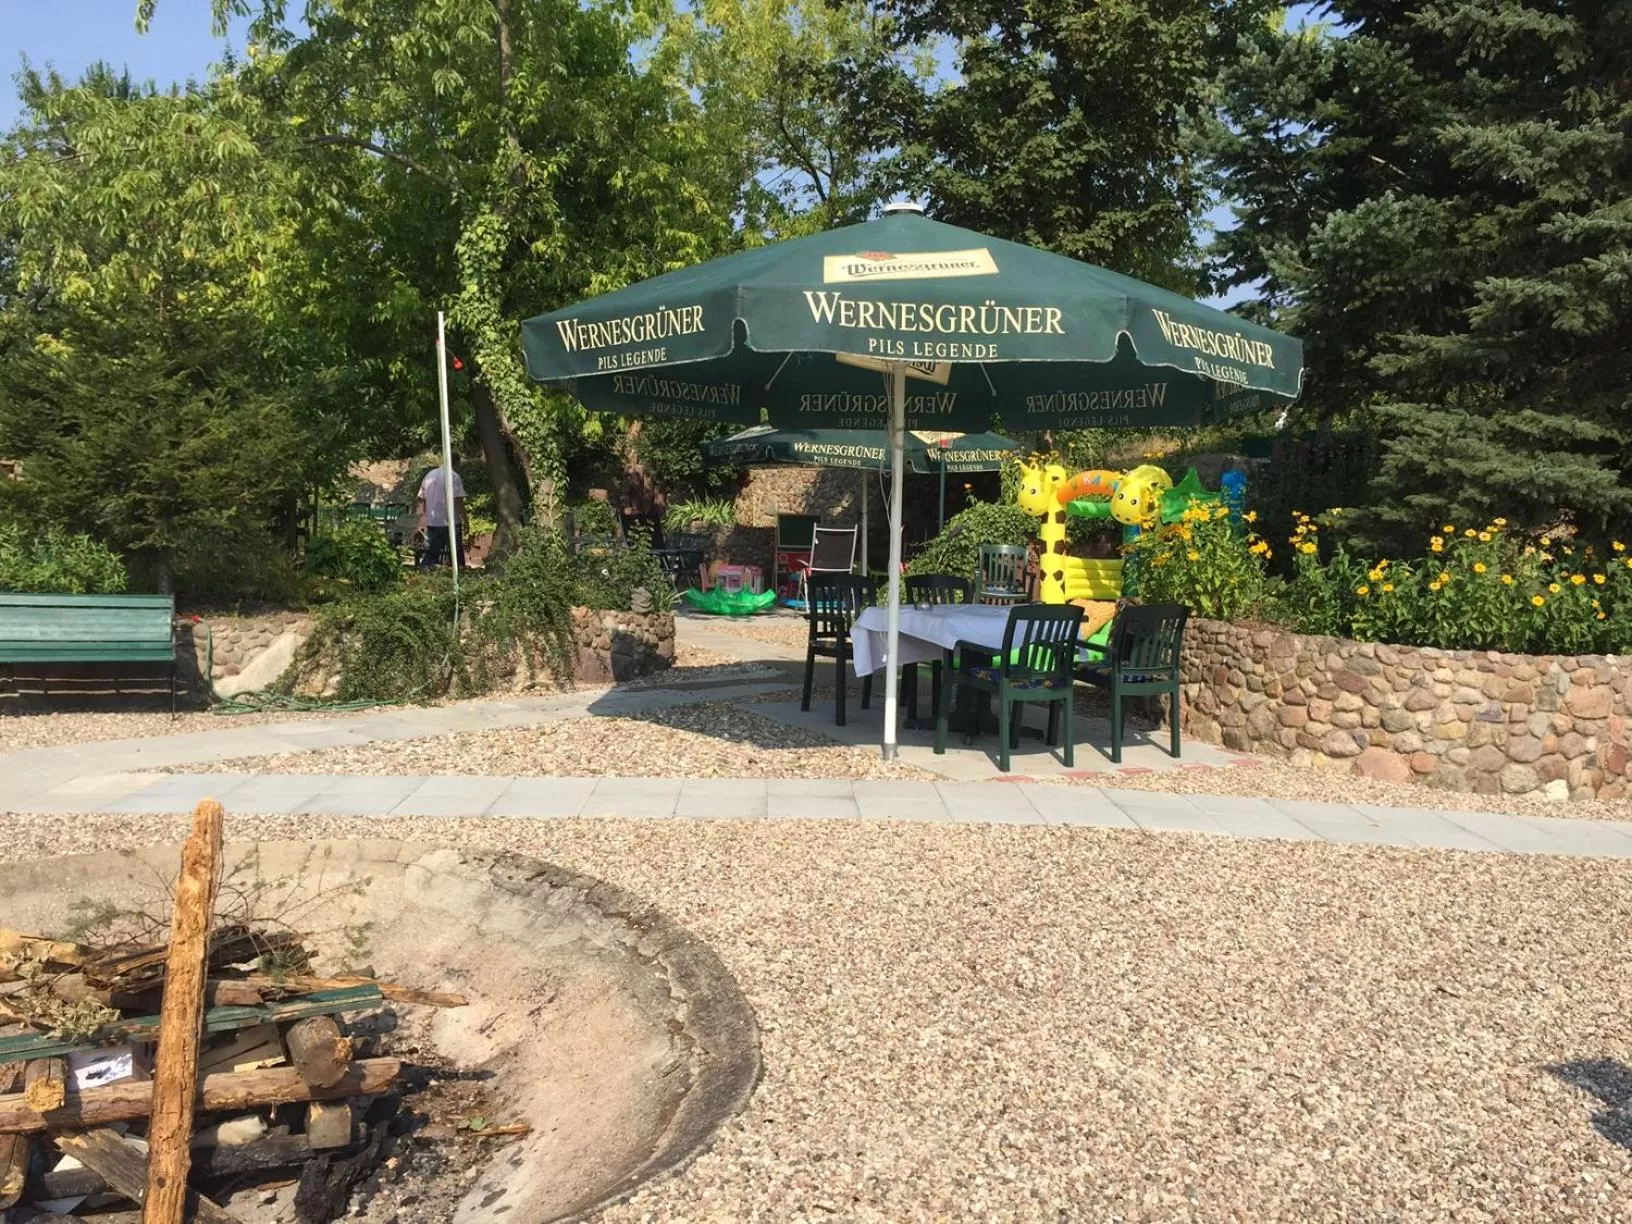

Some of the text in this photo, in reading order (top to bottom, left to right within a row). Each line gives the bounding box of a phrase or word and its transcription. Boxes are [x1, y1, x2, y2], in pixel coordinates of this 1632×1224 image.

[556, 305, 705, 352] WERNESGRÜNER
[803, 291, 1065, 334] WERNESGRÜNER
[598, 347, 667, 369] PILS LEGENDE
[868, 338, 998, 358] PILS LEGENDE
[1151, 308, 1275, 369] WERNESGRÜNER
